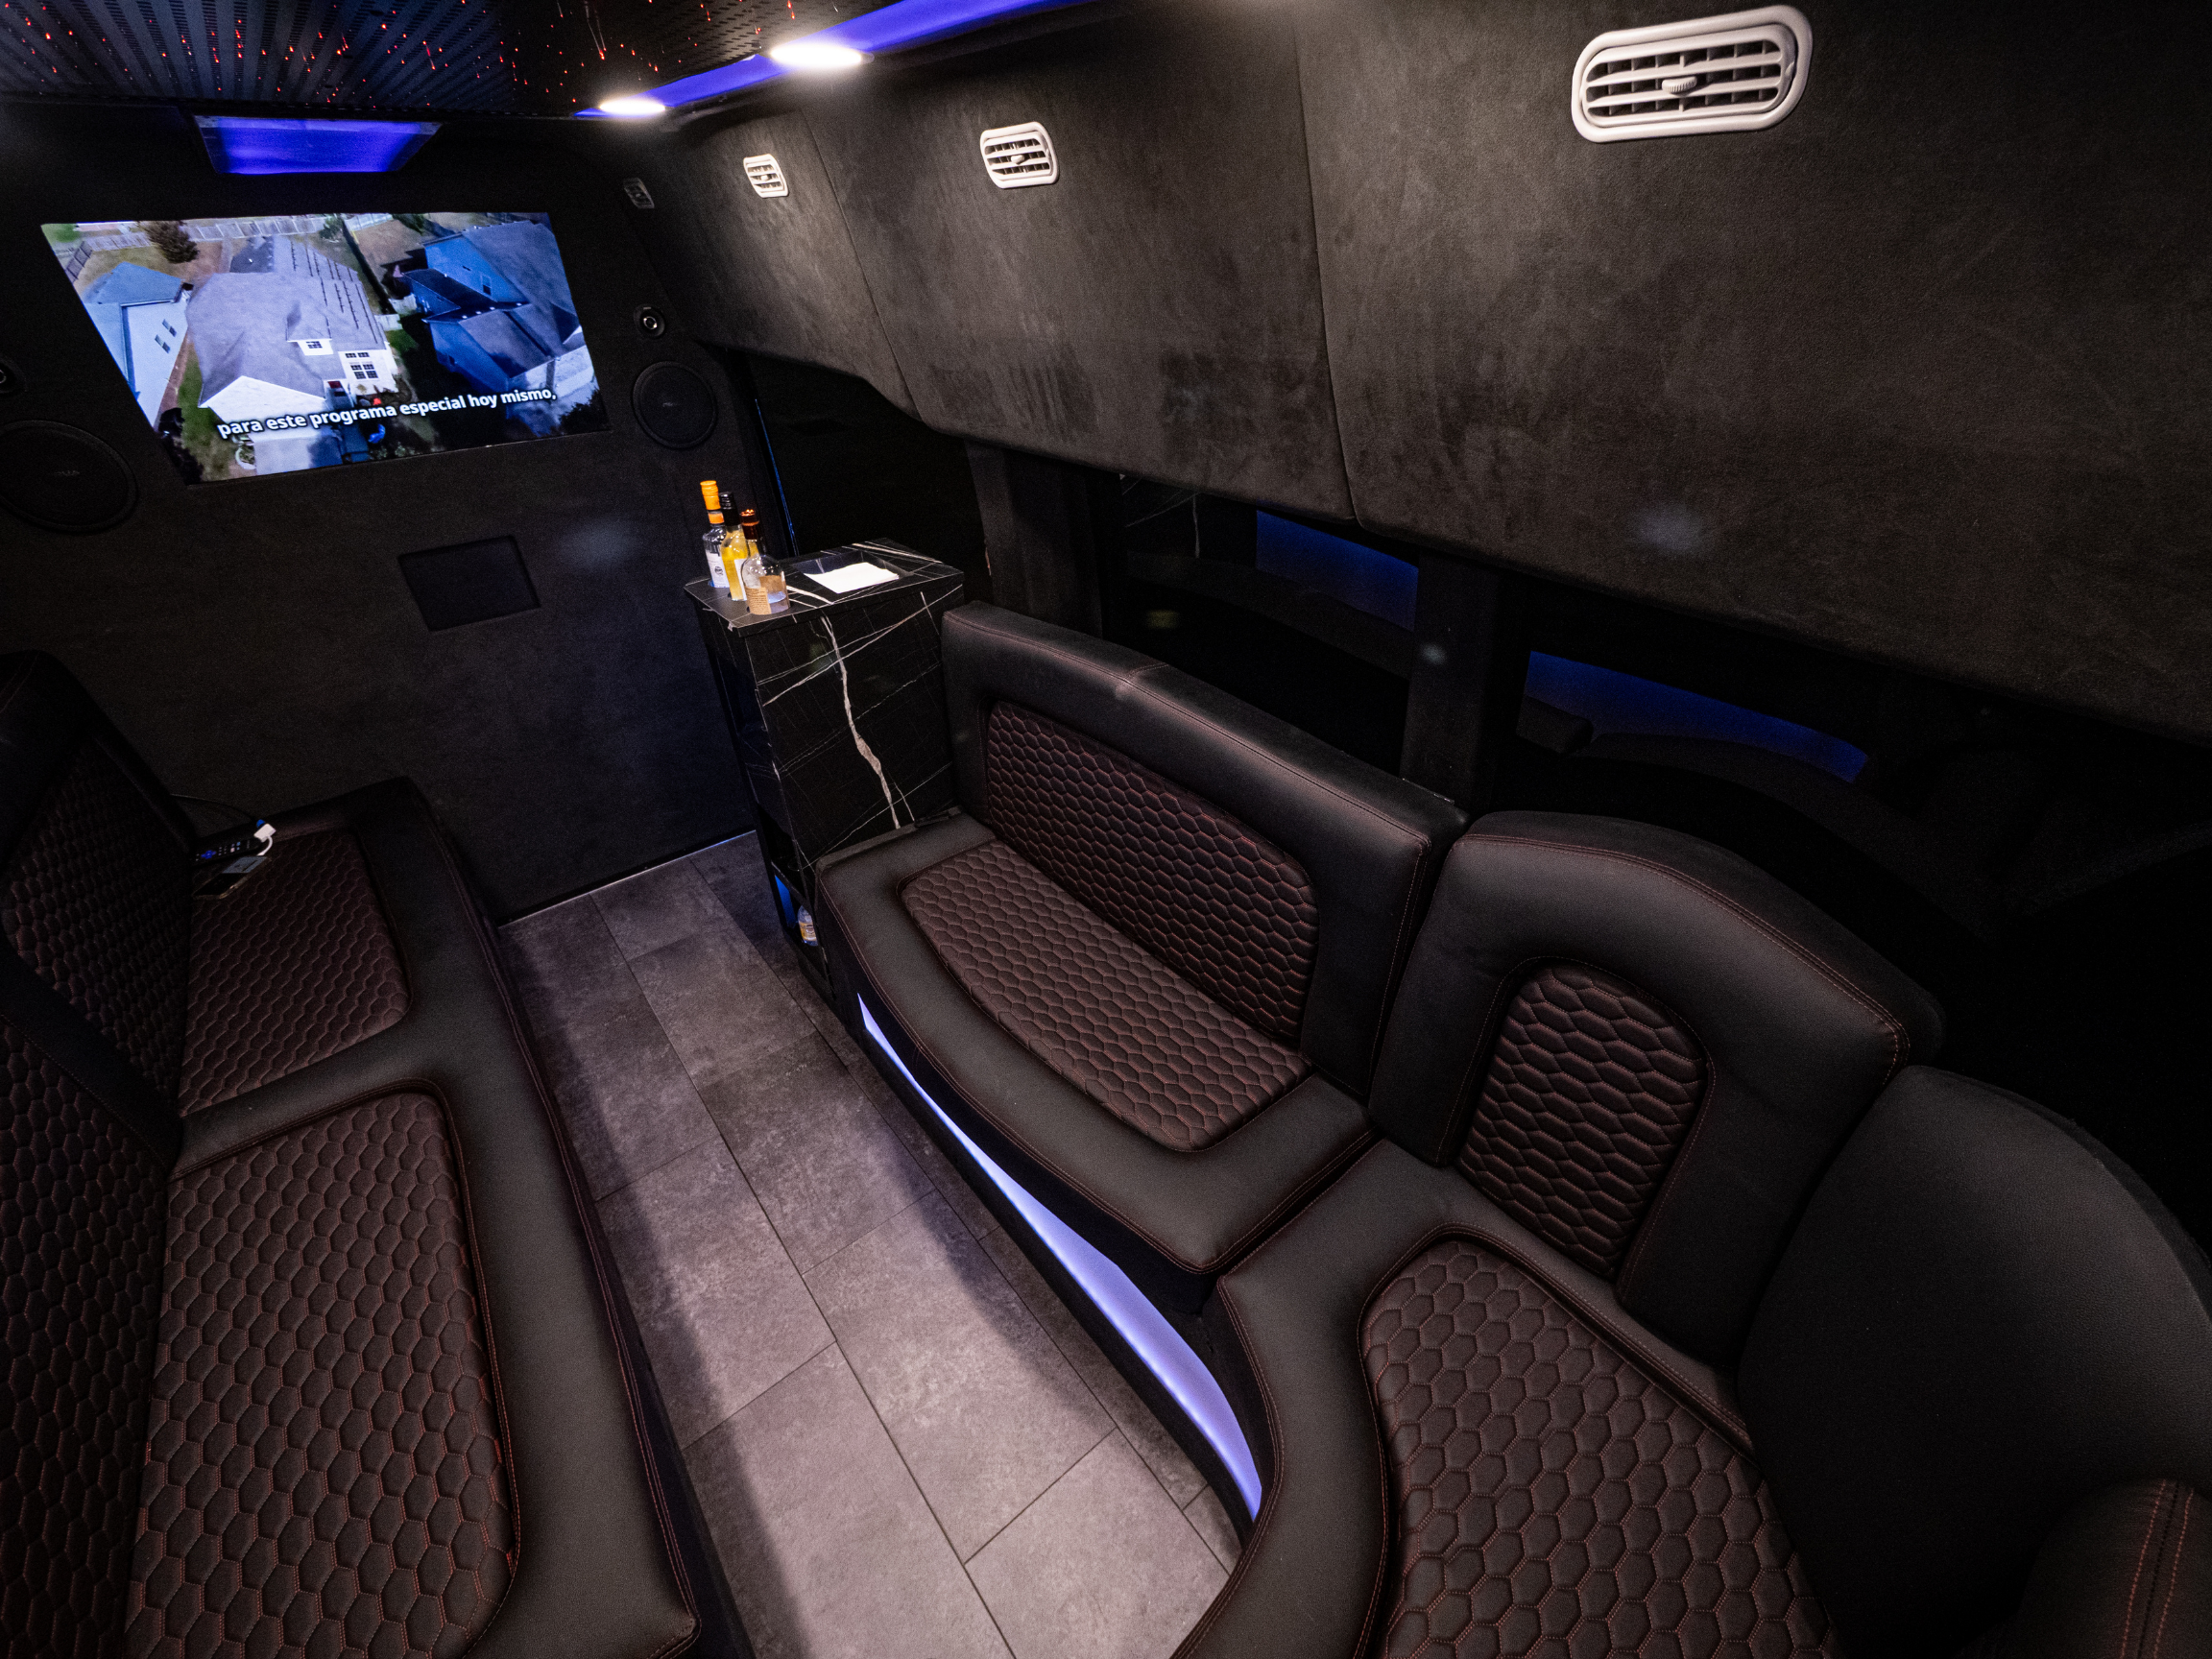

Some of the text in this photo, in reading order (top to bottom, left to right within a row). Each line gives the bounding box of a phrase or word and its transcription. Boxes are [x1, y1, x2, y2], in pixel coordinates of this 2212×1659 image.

[217, 388, 556, 438] para este programa especial hoy mismo,
